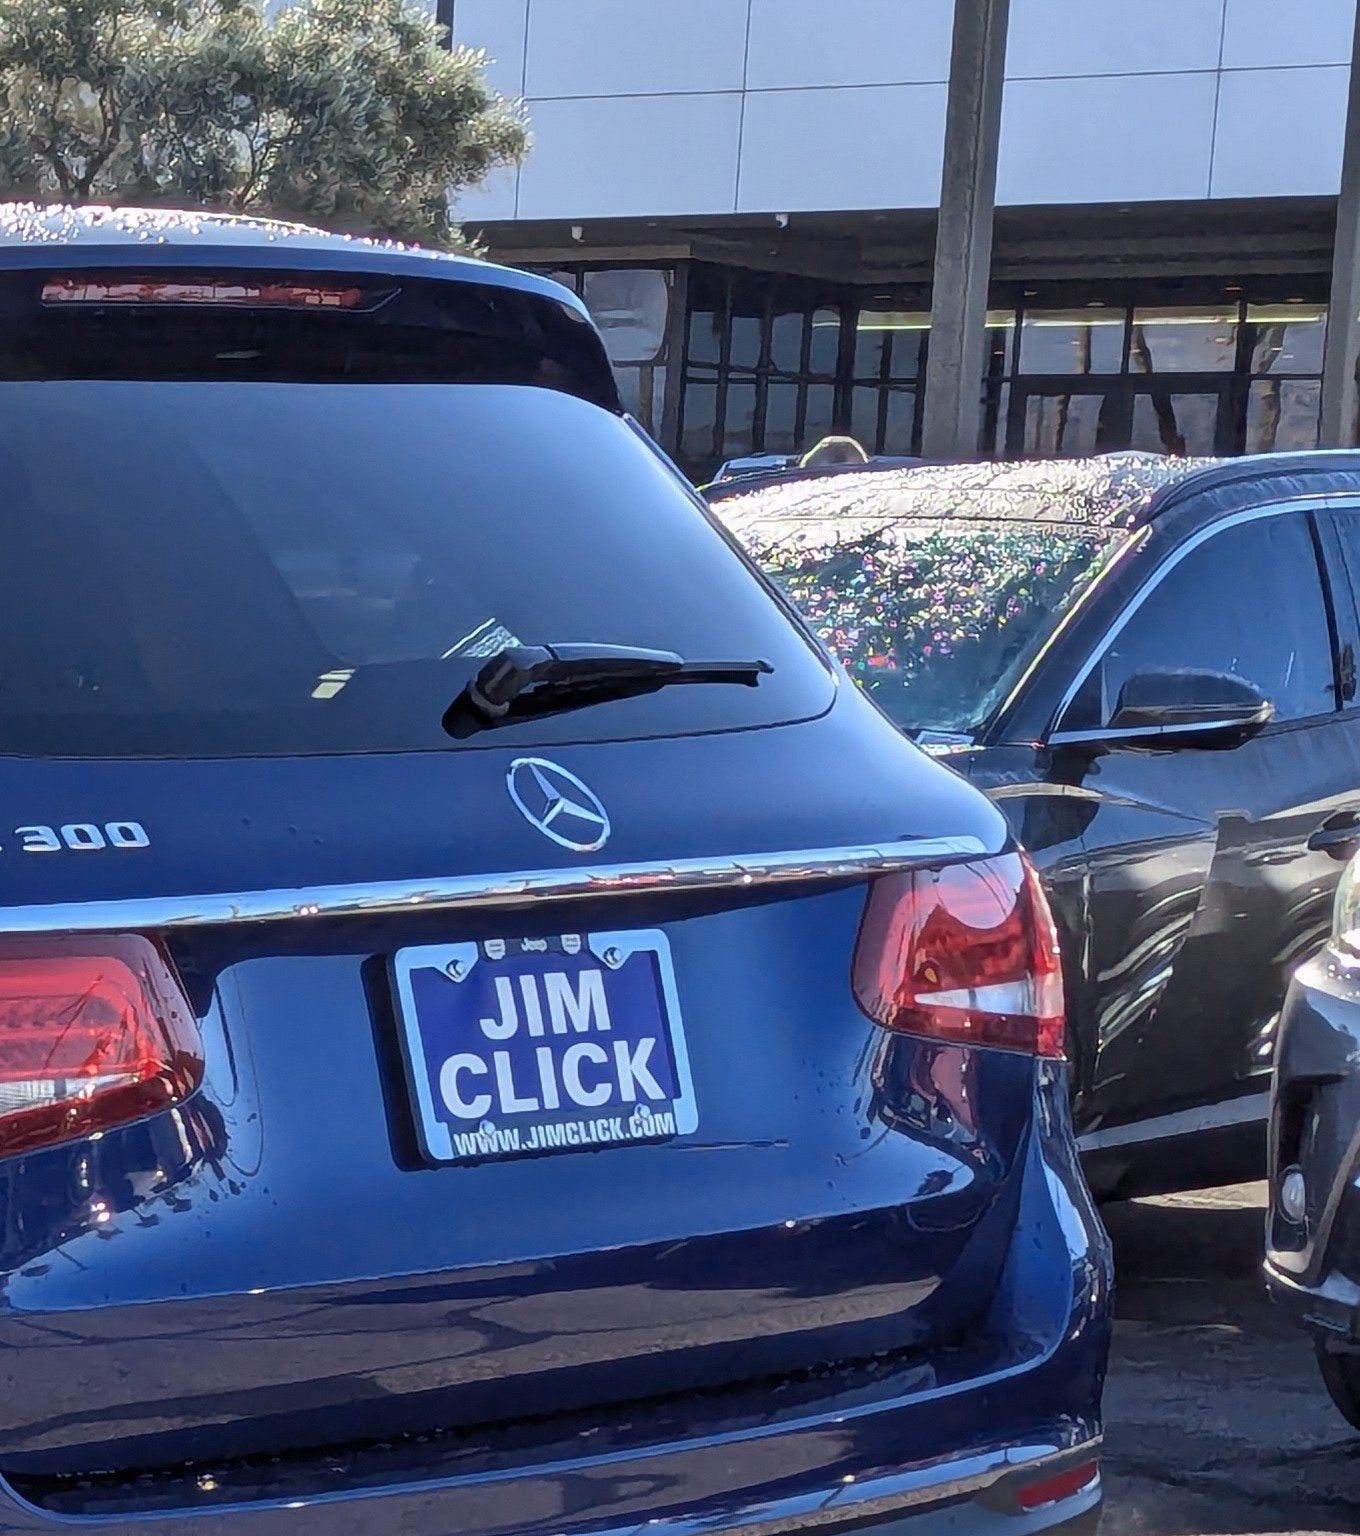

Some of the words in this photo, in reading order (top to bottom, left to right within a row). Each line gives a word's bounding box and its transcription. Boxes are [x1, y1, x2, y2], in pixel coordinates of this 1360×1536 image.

[14, 821, 151, 852] 300
[480, 969, 611, 1040] JIM
[439, 1037, 667, 1120] CLICK
[453, 1112, 676, 1157] WWW.JIMCLICK.COM
